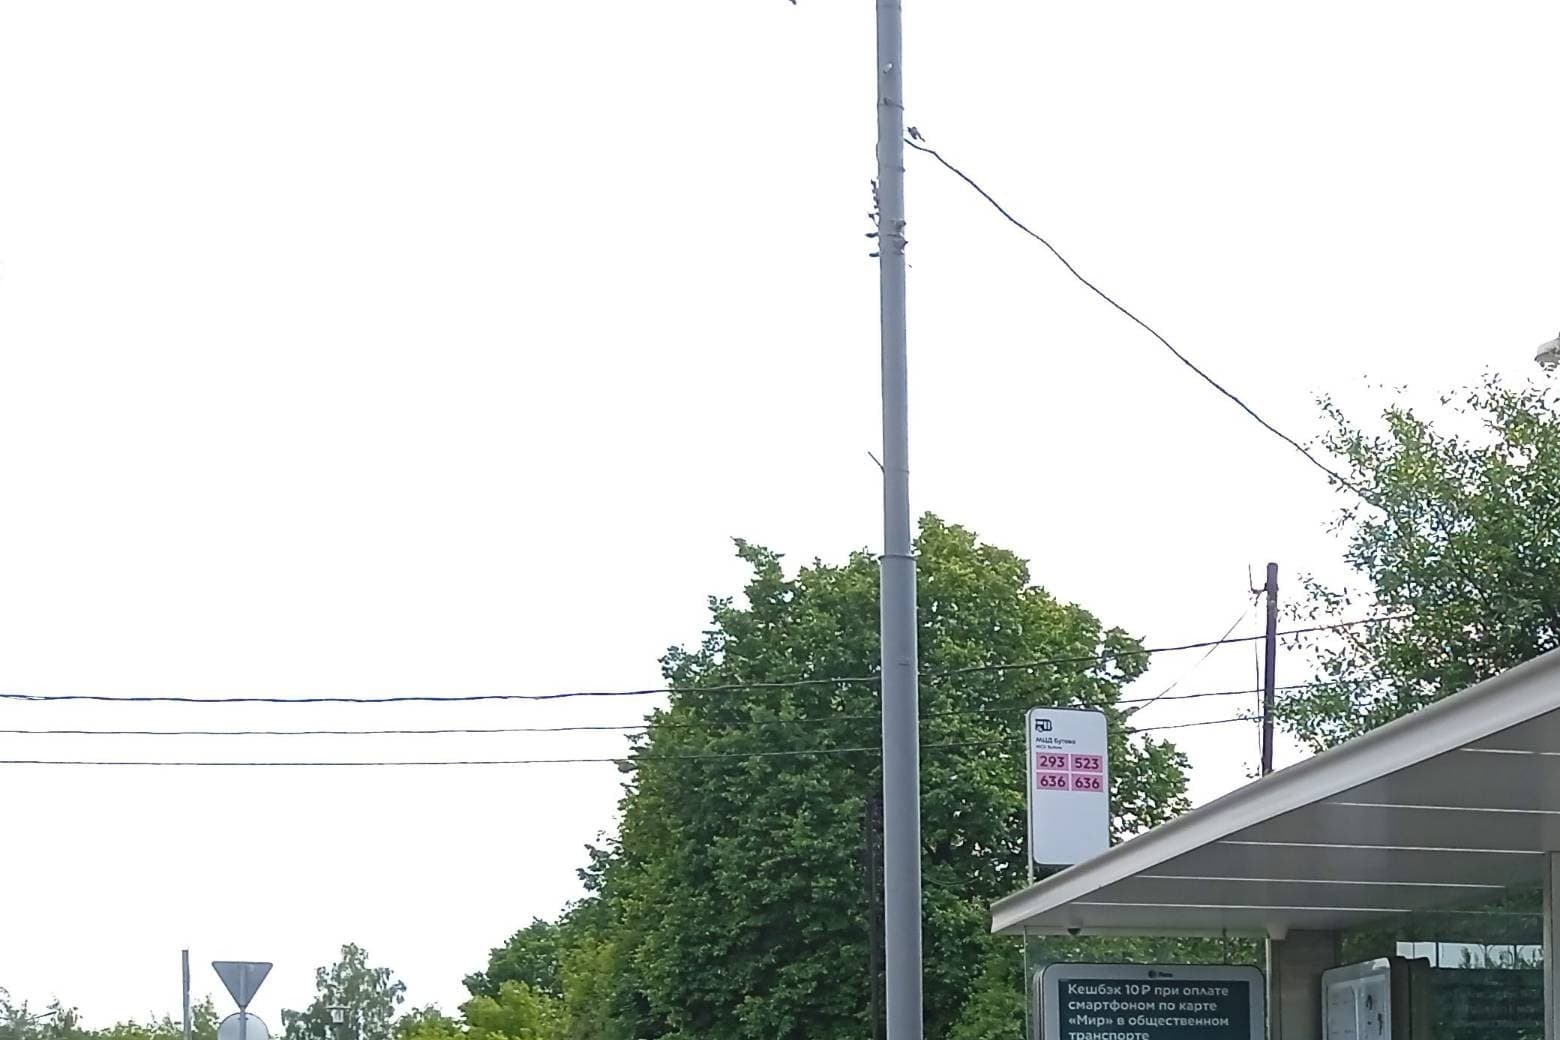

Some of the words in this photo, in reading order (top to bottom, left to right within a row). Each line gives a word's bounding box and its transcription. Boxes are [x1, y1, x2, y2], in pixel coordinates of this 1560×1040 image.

[1040, 755, 1065, 768] 293
[1074, 757, 1099, 770] 523
[1040, 775, 1066, 787] 636
[1075, 777, 1100, 789] 636
[1068, 984, 1122, 995] Кешбэк
[1154, 986, 1180, 997] при
[1182, 986, 1229, 996] оплате
[1068, 1000, 1155, 1012] смартфоном
[1158, 1001, 1176, 1011] по
[1179, 1001, 1217, 1012] карте
[1068, 1015, 1113, 1027] «Мир»
[1116, 1016, 1125, 1026] в
[1128, 1015, 1229, 1027] общественном
